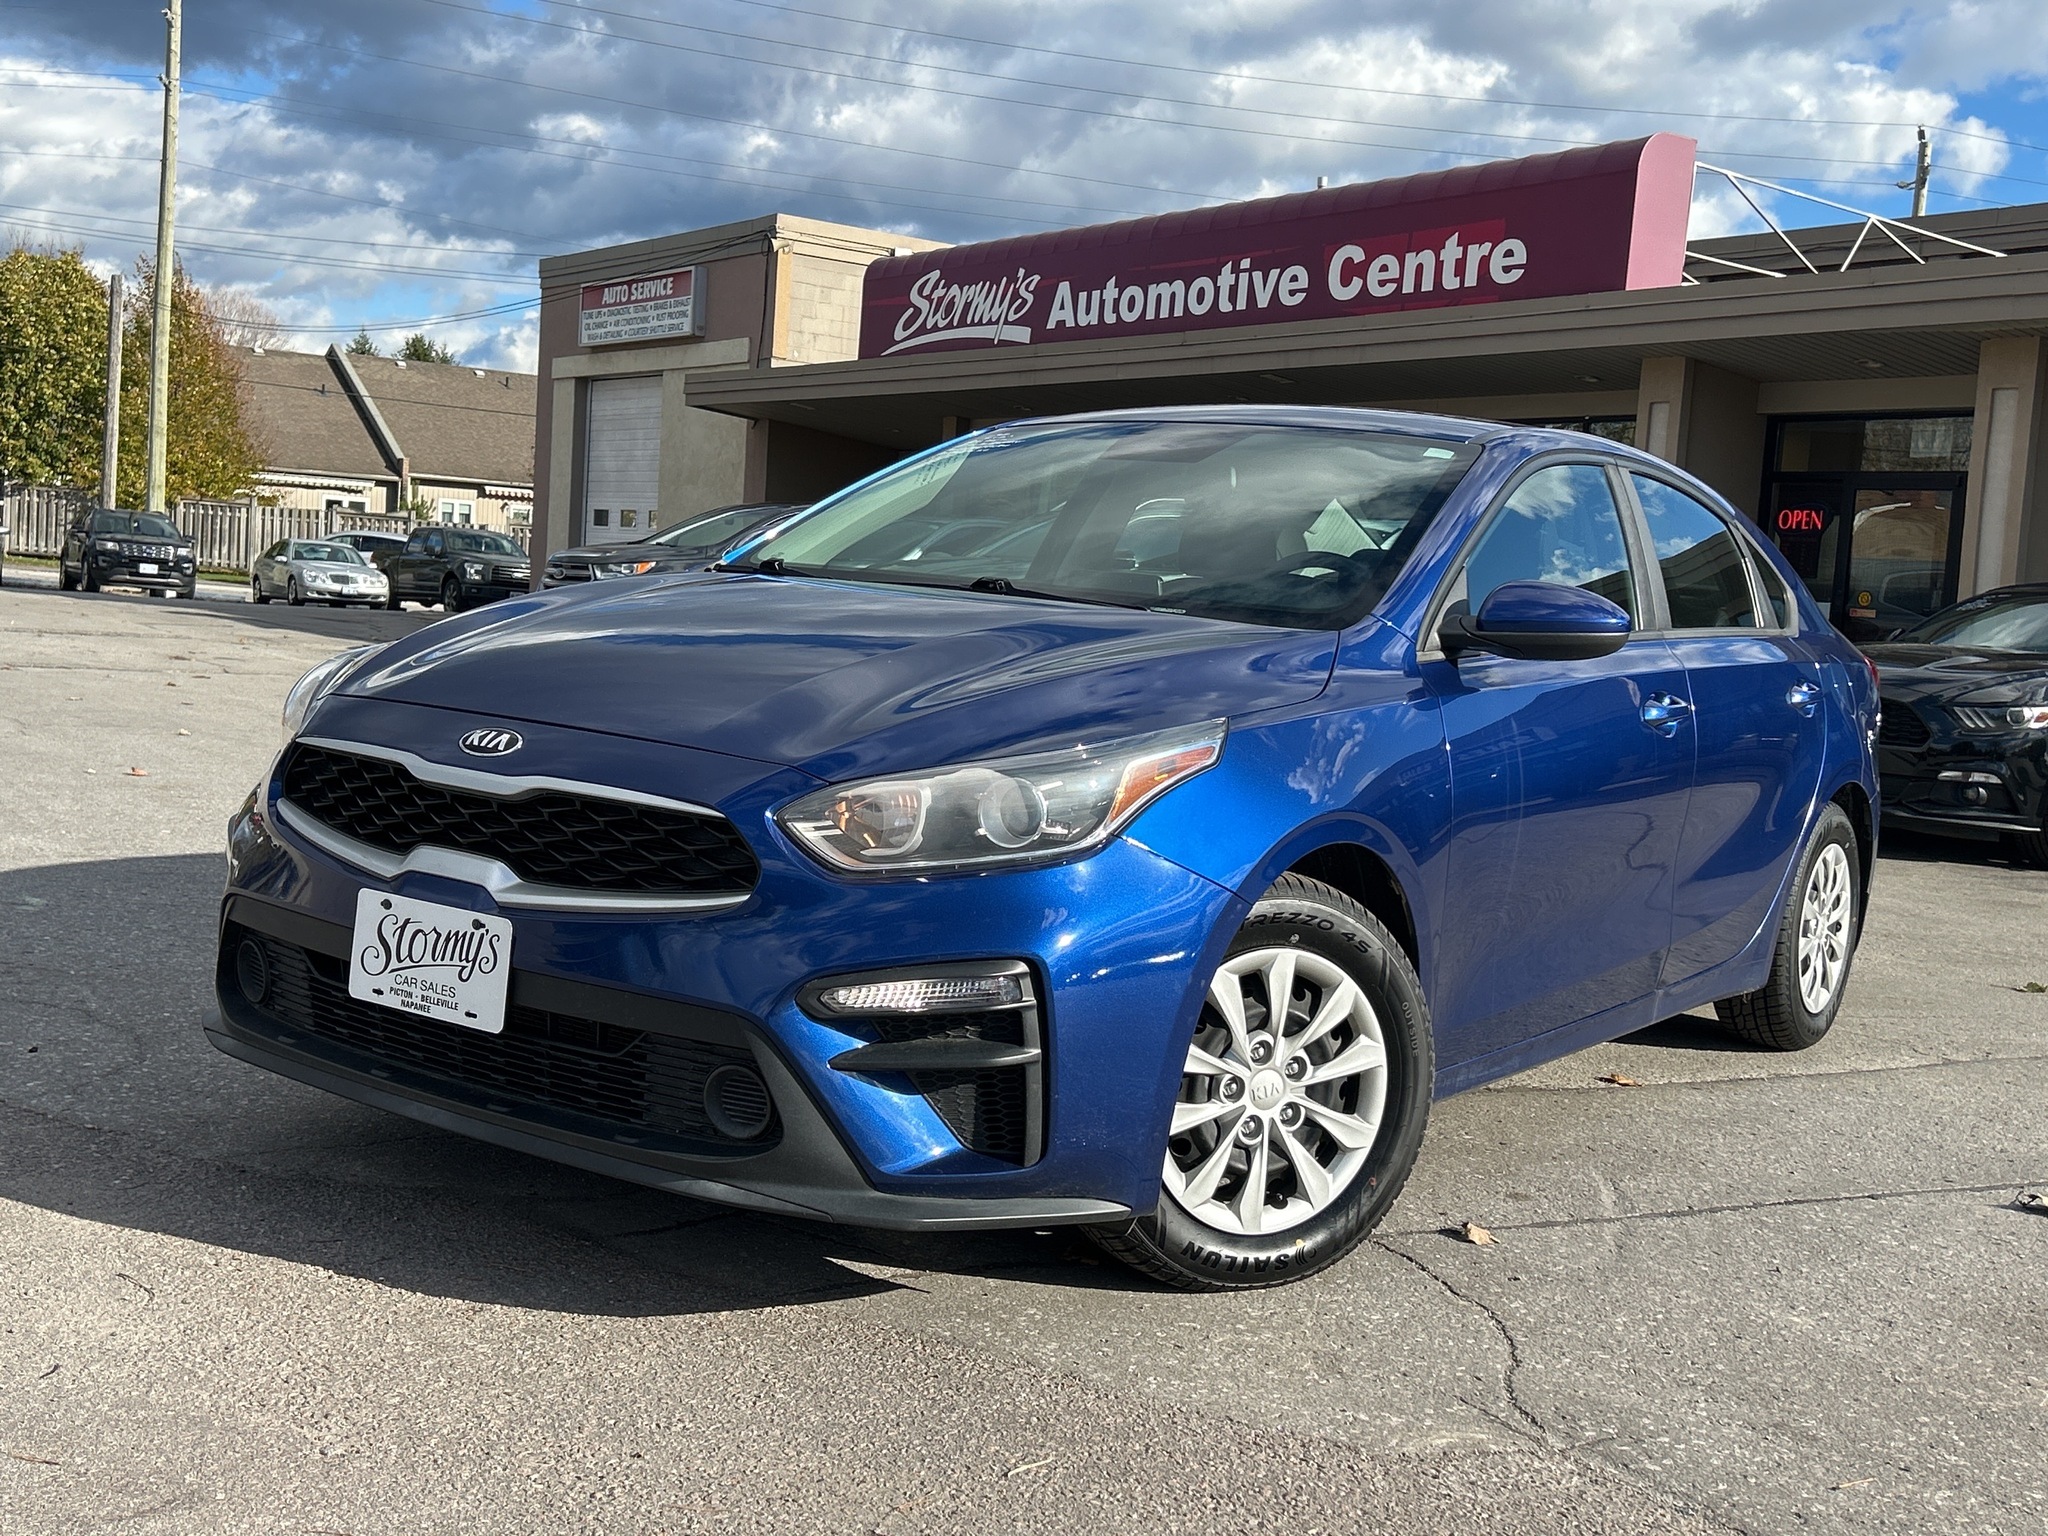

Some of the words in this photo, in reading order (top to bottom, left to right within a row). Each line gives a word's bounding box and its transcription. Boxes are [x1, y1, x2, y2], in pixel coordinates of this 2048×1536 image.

[602, 284, 629, 305] AUTO
[630, 277, 674, 301] SERVICE
[893, 267, 1041, 344] Stormy's
[1046, 258, 1309, 330] Automotive
[1327, 231, 1527, 301] Centre
[1778, 509, 1824, 530] OPEN
[465, 730, 511, 751] KIA
[361, 914, 500, 983] Stormy's
[394, 973, 418, 989] CAR
[420, 980, 456, 998] SALES
[389, 986, 413, 999] PICTON
[421, 994, 459, 1011] BELLEVILLE
[400, 999, 431, 1014] NAPANEE
[1402, 1001, 1419, 1057] OUTSIDE
[1251, 1082, 1280, 1101] KIA
[1180, 1240, 1290, 1273] SAILUN
